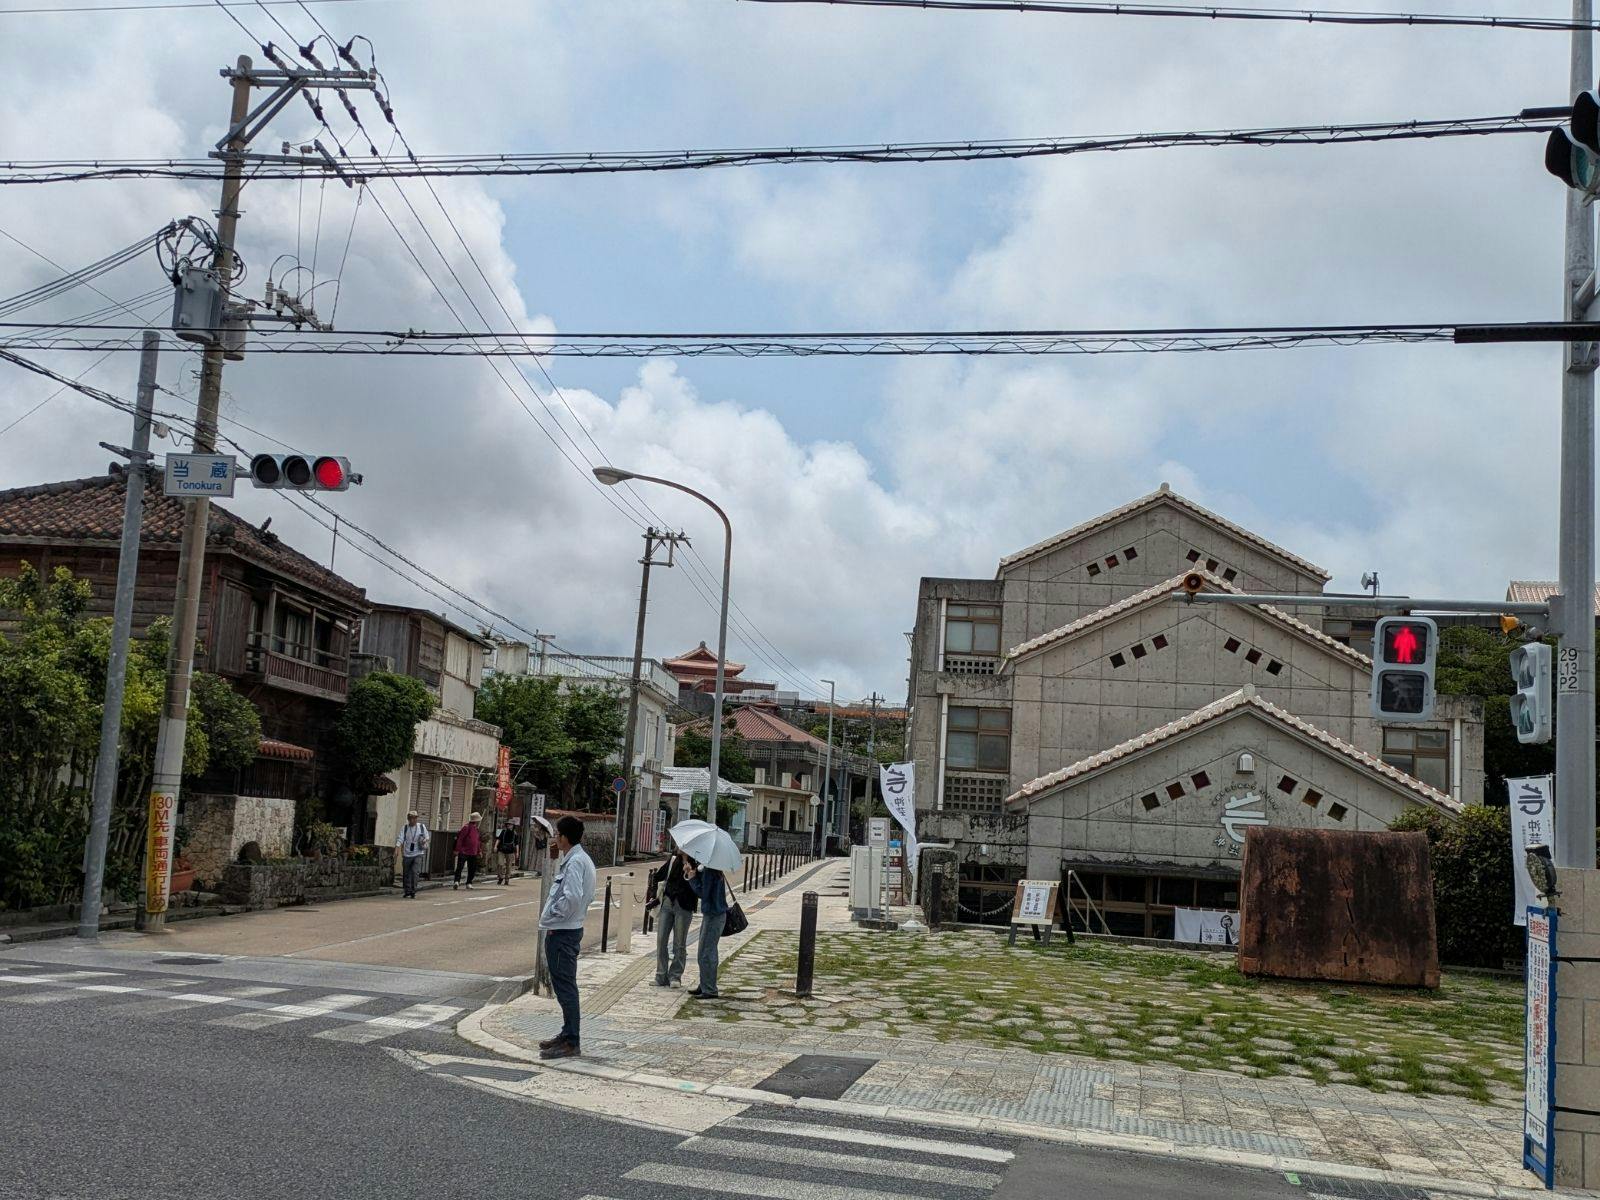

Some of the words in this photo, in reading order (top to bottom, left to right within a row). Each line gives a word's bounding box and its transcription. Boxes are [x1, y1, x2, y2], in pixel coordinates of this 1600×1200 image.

[173, 460, 228, 478] 当蔵
[177, 480, 222, 490] Tonokura
[1560, 648, 1577, 661] 29
[1560, 676, 1577, 689] P2
